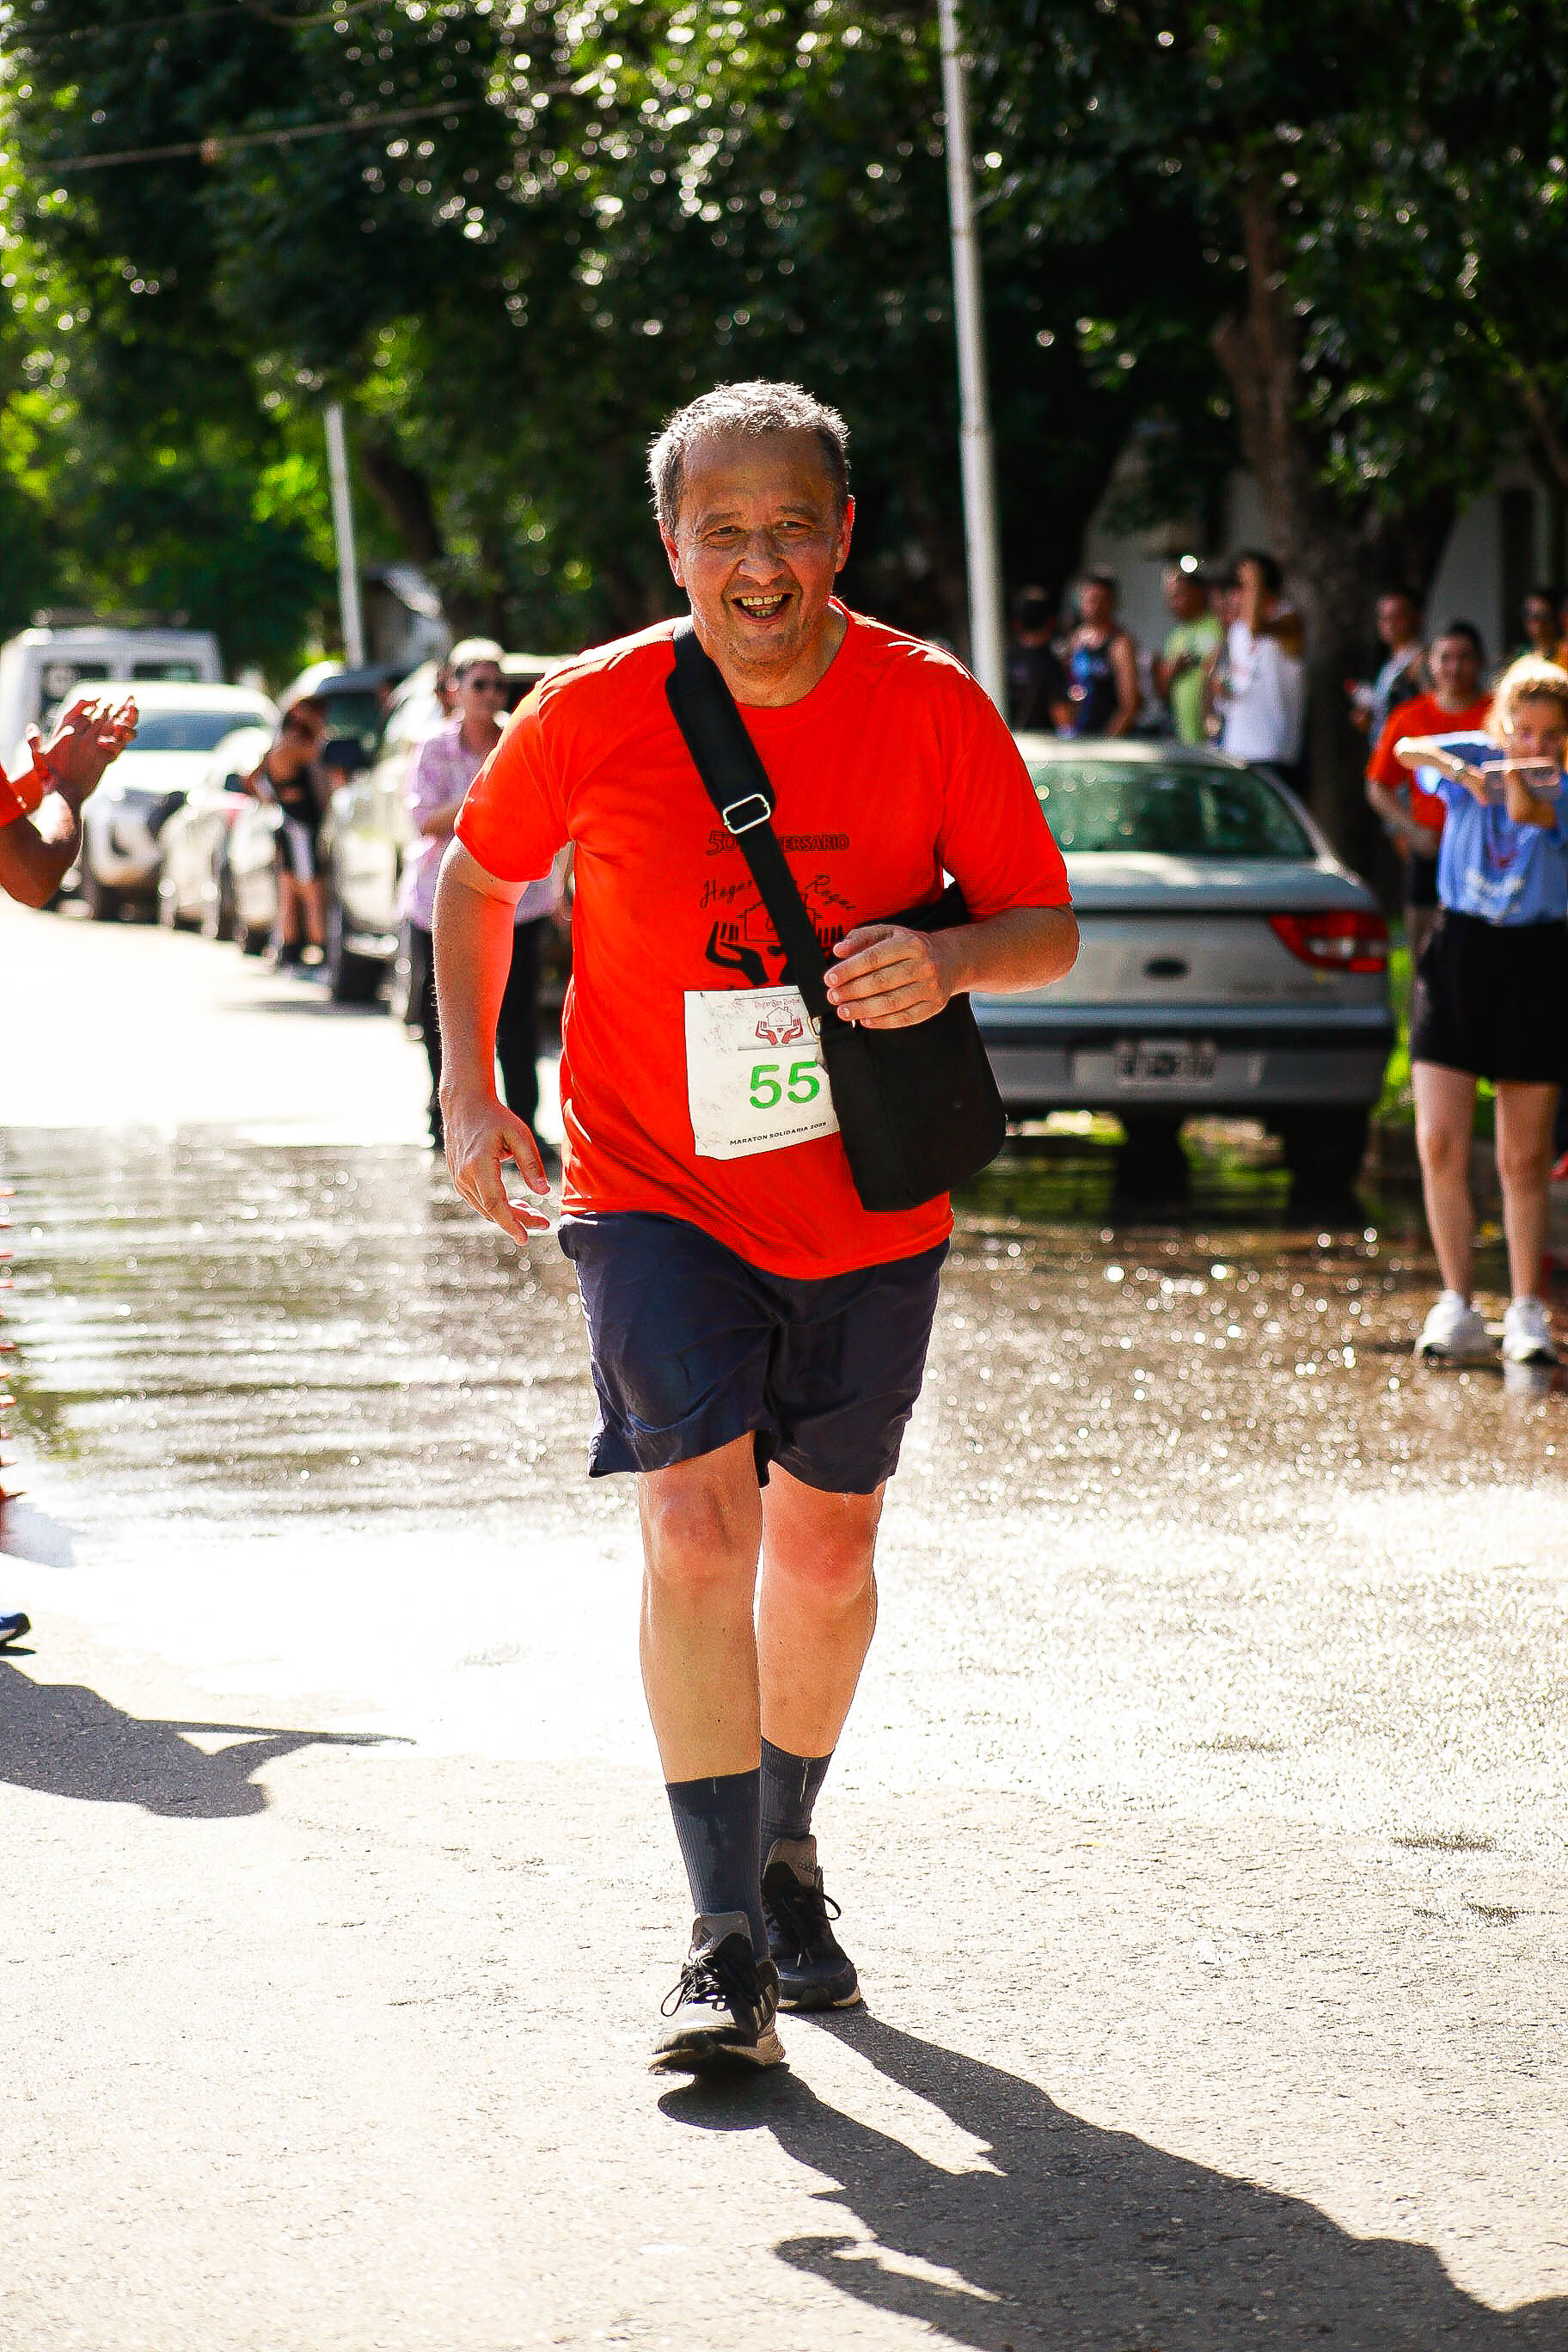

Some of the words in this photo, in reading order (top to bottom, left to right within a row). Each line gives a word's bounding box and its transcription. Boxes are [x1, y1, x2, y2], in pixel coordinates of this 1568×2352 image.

[750, 1060, 820, 1110] 55
[730, 1135, 768, 1146] MARATON
[769, 1126, 808, 1139] SOLIDARIA
